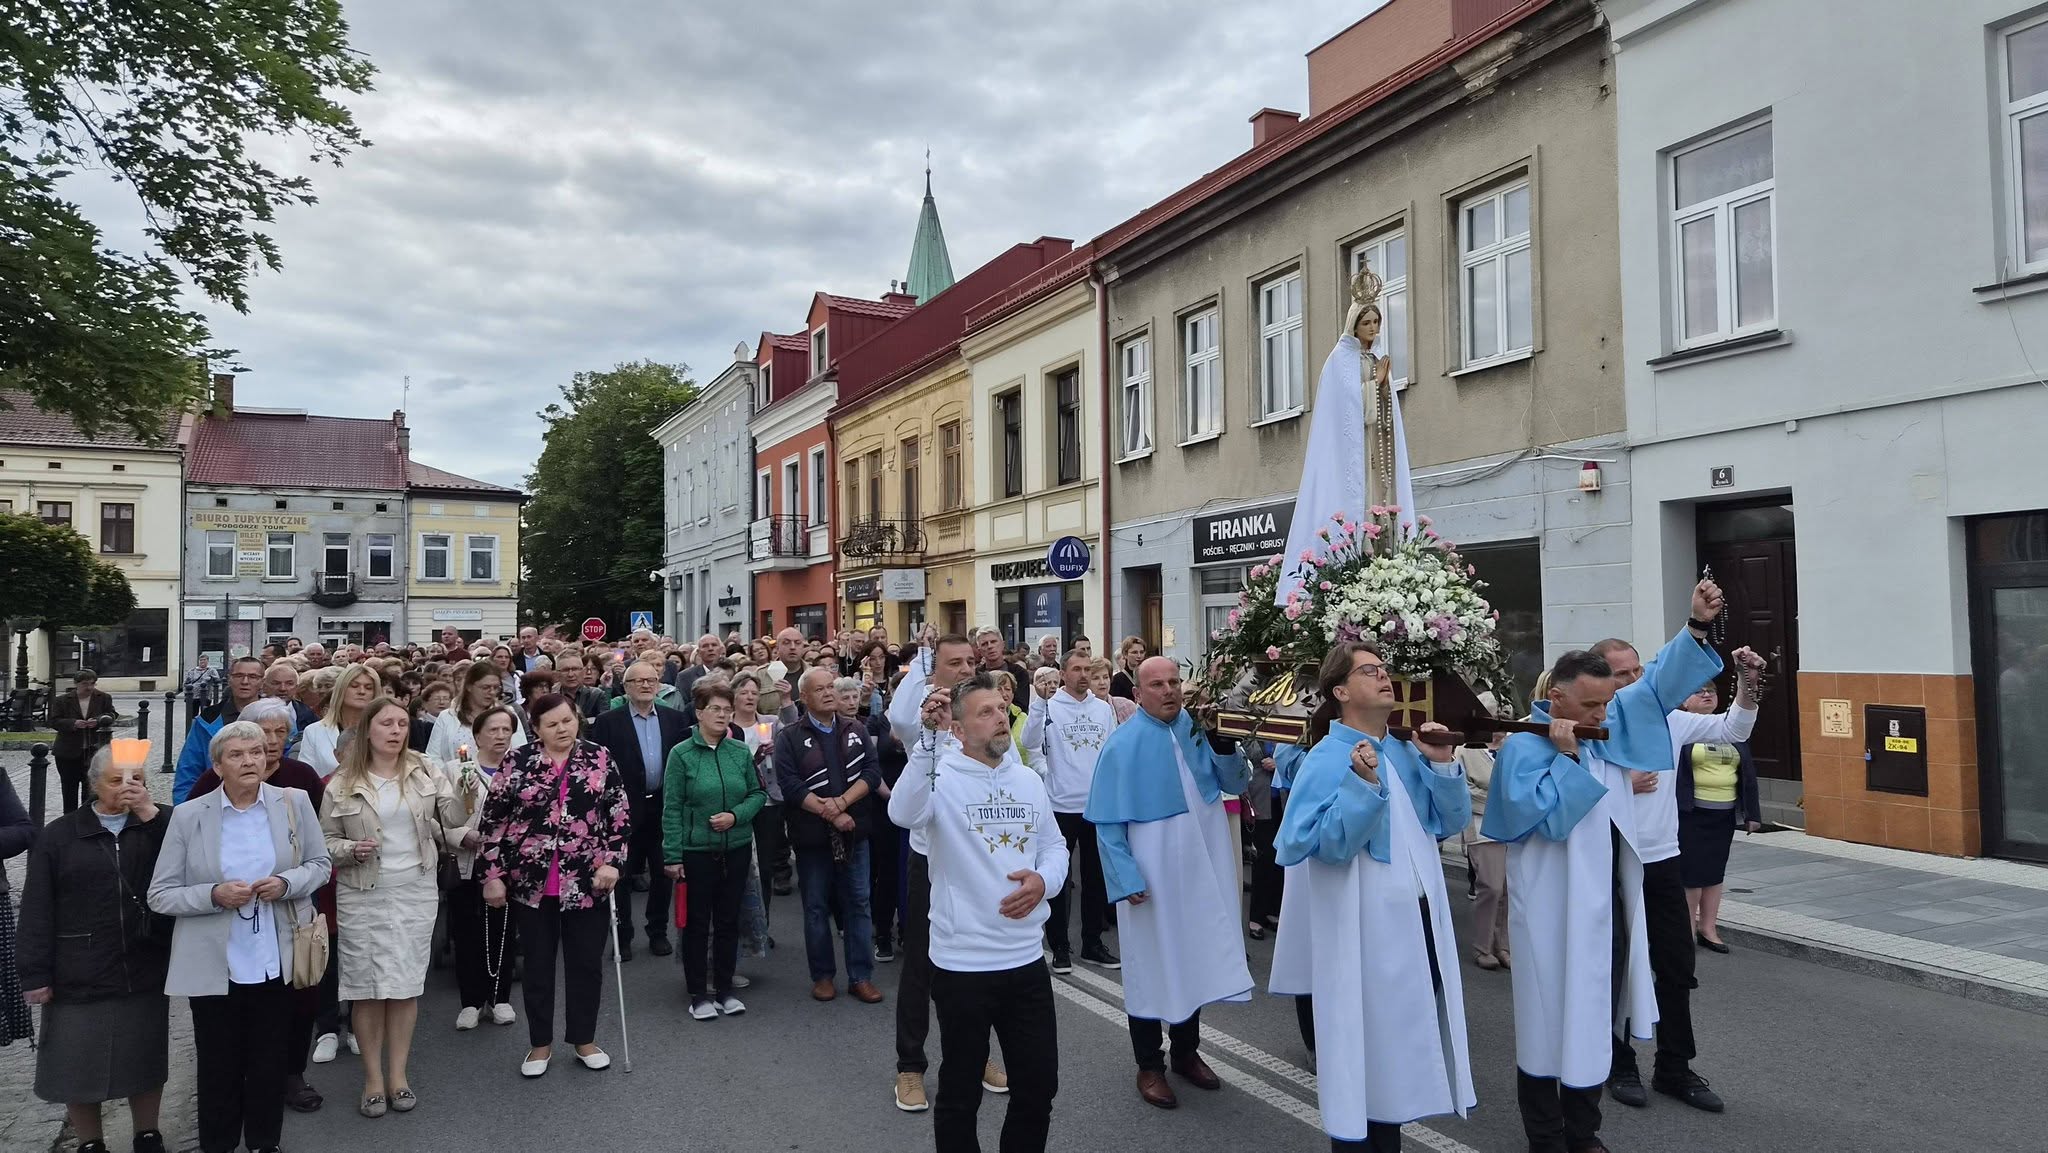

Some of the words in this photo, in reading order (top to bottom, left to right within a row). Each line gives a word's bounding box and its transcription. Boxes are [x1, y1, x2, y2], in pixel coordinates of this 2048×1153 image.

[1719, 468, 1725, 479] 6
[195, 513, 229, 522] BIURO
[234, 515, 307, 525] TURYSTYCZNE
[1209, 513, 1276, 541] FIRANKA
[1202, 545, 1225, 556] POŚCIEL
[1229, 542, 1255, 555] RĘCZNIKI
[1259, 538, 1285, 549] OBRUSY
[1059, 564, 1084, 572] BUFIX
[584, 625, 604, 633] STOP
[1004, 807, 1026, 819] TUUS
